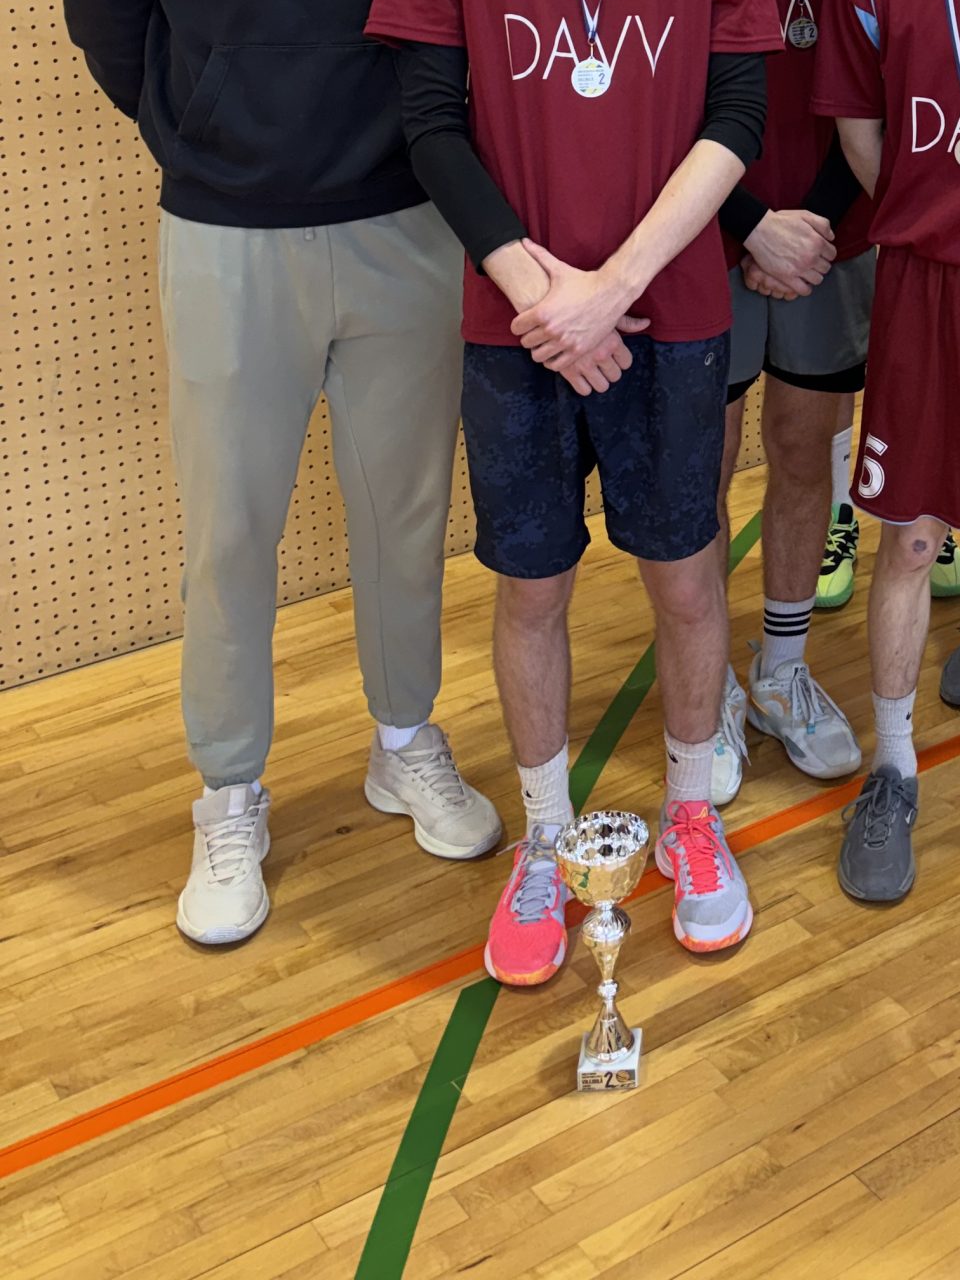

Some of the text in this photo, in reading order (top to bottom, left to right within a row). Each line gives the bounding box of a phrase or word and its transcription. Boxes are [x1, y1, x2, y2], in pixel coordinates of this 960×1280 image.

[809, 27, 815, 38] 2
[504, 13, 675, 81] DAVV
[598, 72, 606, 85] 2
[603, 1070, 619, 1088] 2
